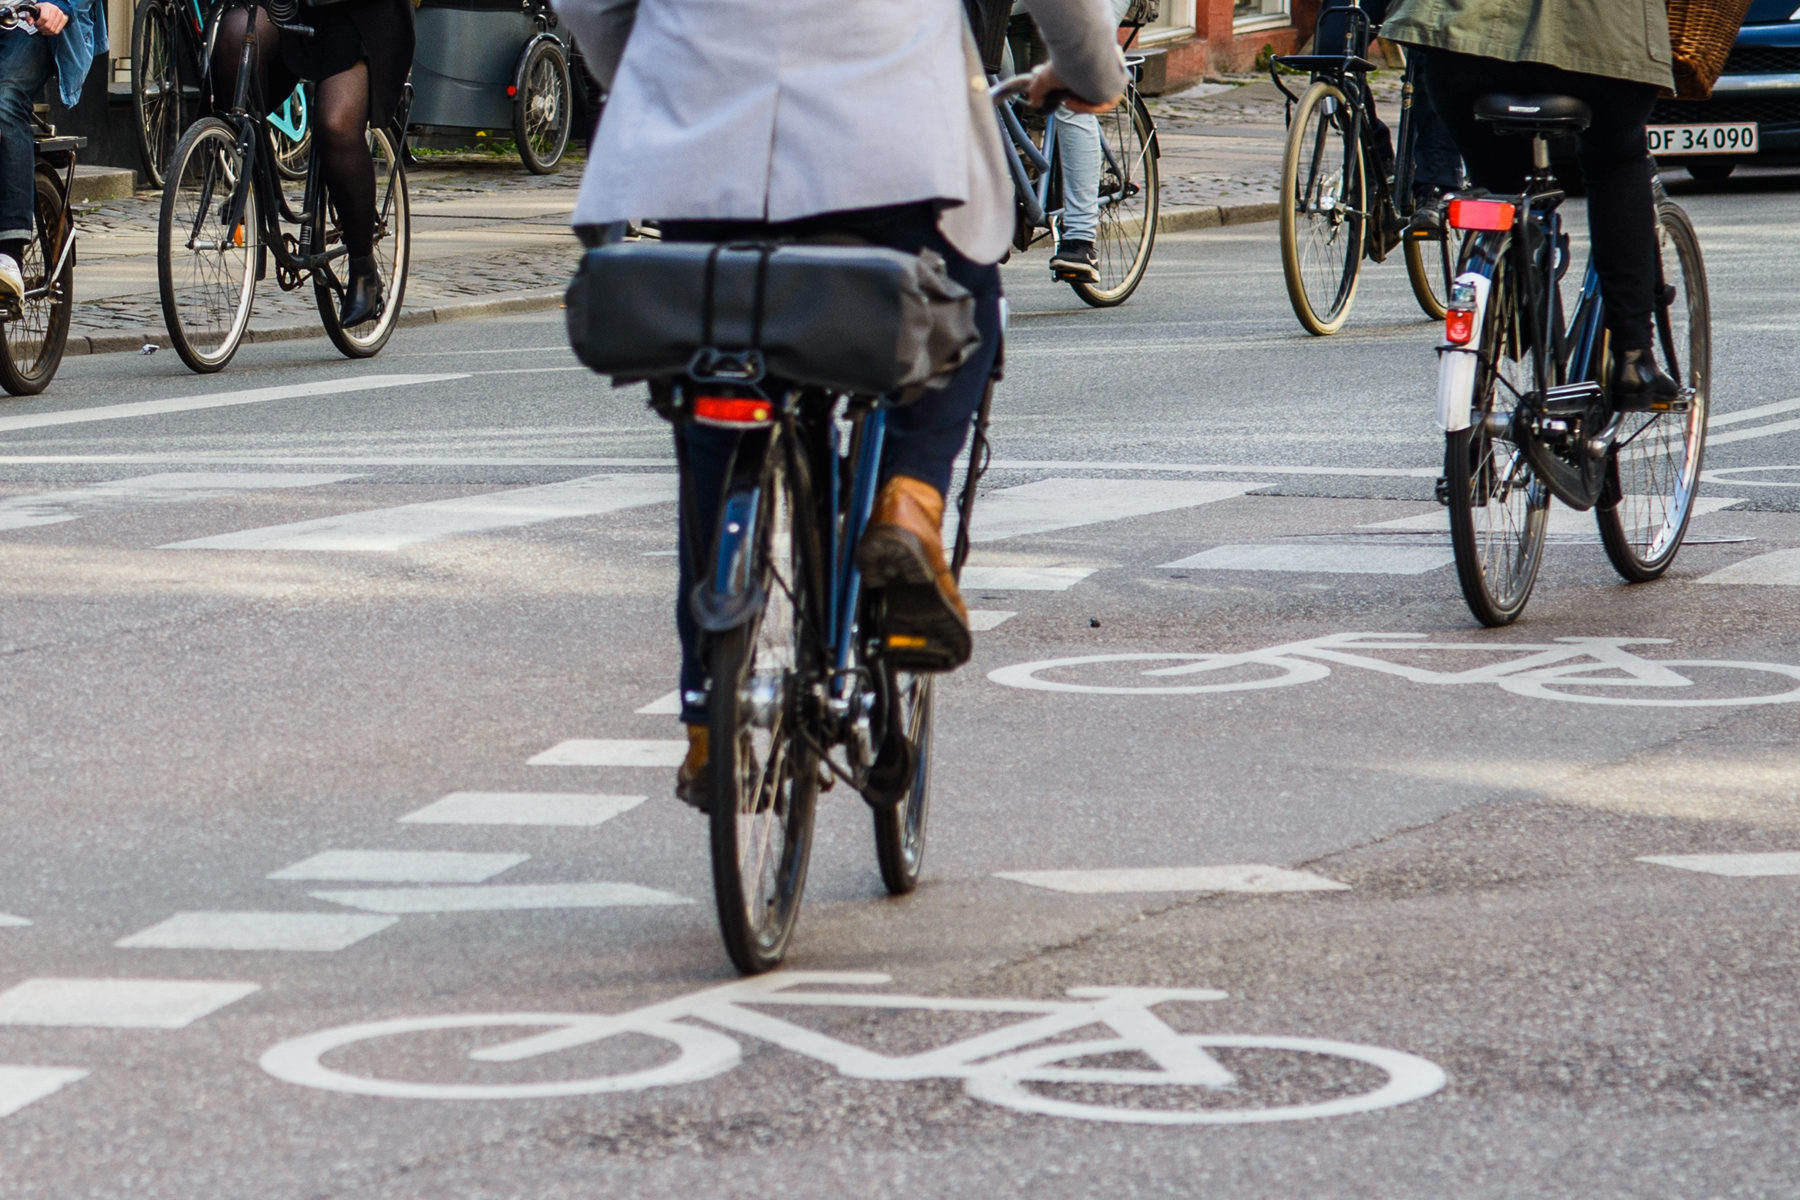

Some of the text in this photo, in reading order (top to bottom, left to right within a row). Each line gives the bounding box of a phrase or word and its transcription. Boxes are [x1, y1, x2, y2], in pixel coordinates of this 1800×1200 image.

[1647, 127, 1755, 150] DF 34 090
